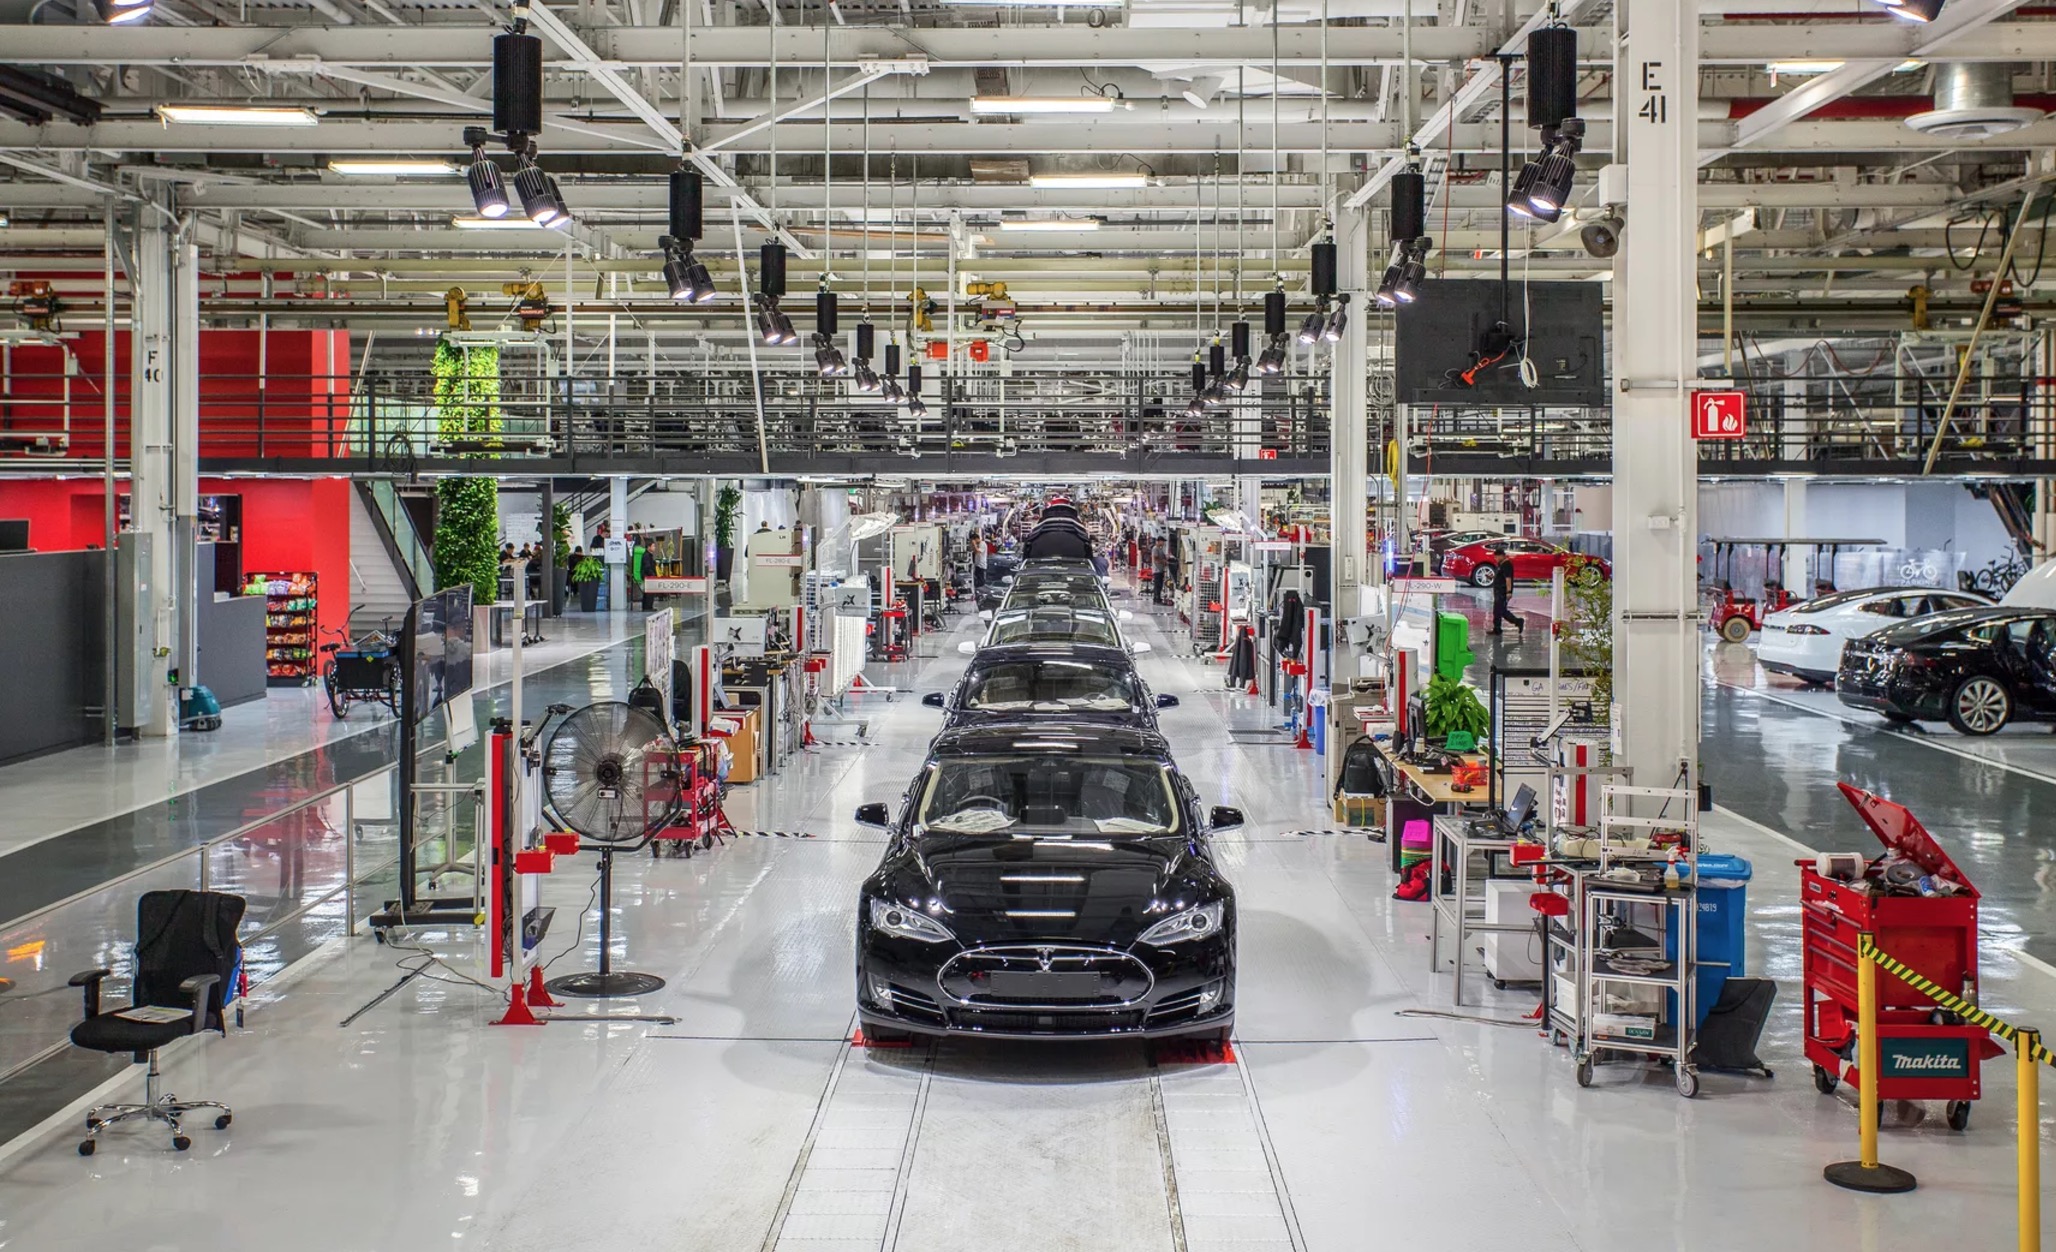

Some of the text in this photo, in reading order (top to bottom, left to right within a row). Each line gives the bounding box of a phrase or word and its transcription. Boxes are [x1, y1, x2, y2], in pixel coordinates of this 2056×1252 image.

[1642, 61, 1662, 91] E
[1638, 95, 1666, 124] 41
[148, 350, 158, 365] F
